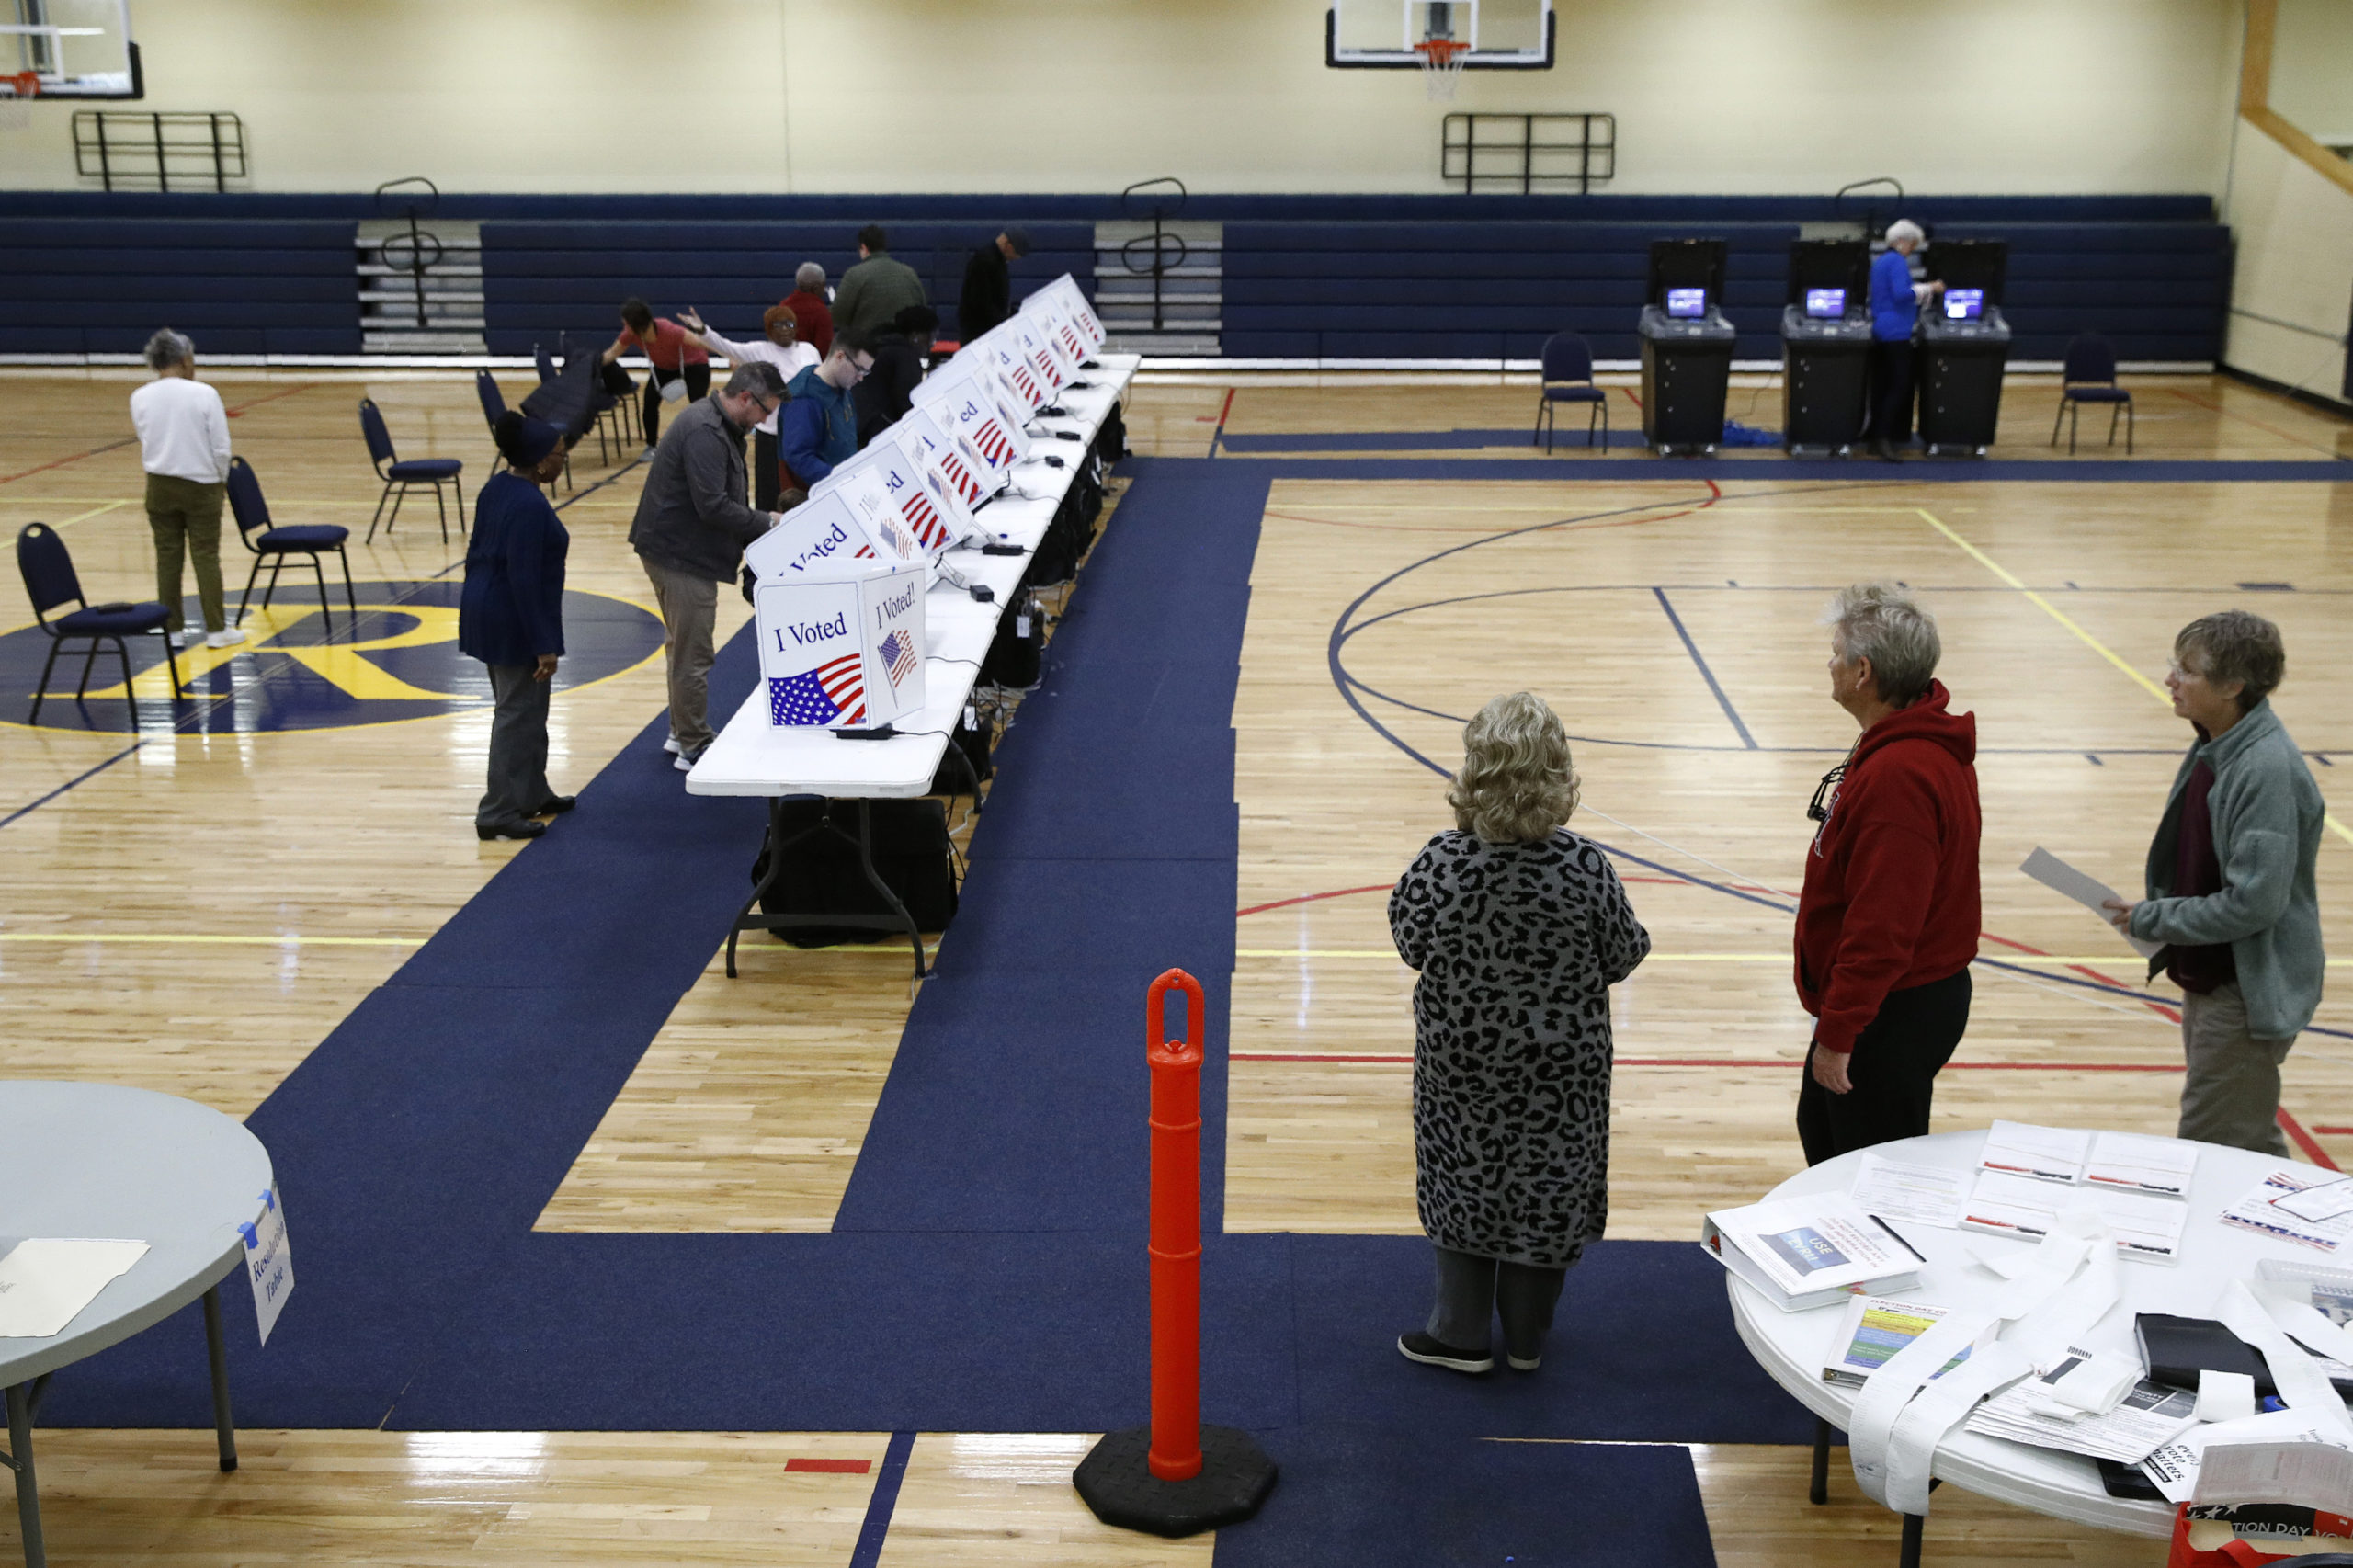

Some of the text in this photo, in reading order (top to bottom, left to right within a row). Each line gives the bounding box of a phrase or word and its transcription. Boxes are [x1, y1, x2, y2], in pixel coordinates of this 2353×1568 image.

[876, 581, 915, 630] I Voted!
[774, 611, 847, 653] I Voted
[252, 1221, 285, 1283] Resolution
[1809, 1238, 1833, 1255] USE
[266, 1265, 283, 1303] Table
[2163, 1446, 2186, 1463] vote
[2276, 1523, 2311, 1536] DAY
